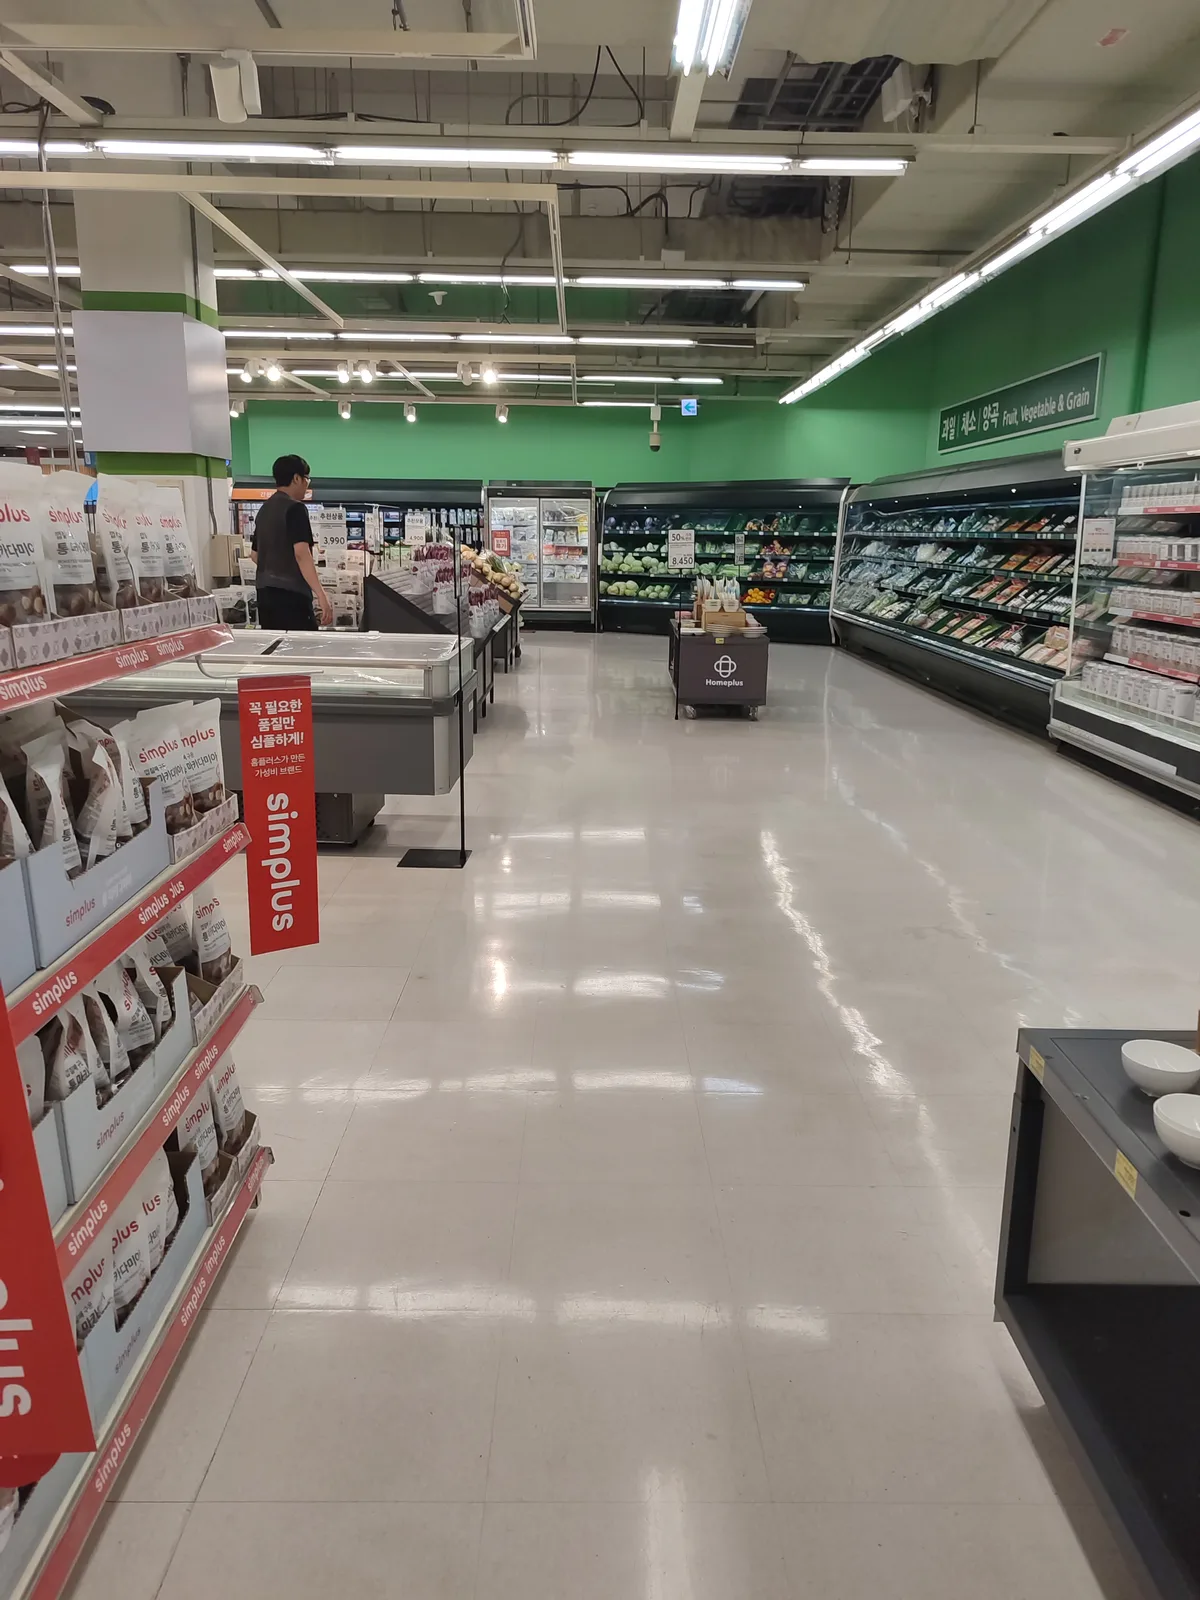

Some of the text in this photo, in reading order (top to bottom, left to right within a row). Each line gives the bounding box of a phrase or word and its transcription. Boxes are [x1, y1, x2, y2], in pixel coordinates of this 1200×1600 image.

[941, 401, 1000, 441] 과일 채소 양곡
[1002, 387, 1090, 427] Fruit, Vegetable & Grain
[323, 536, 345, 545] 3,990
[672, 557, 693, 565] 8,450
[115, 649, 150, 669] simplus
[157, 639, 185, 658] simplus
[0, 674, 47, 701] simplus
[705, 678, 744, 687] Homeplus
[249, 698, 302, 714] 꼭 필요한
[258, 716, 295, 731] 품질만
[250, 732, 304, 749] 심플하게!
[250, 753, 305, 767] 홈플러스가 만든
[255, 764, 303, 778] 가성비 브랜드
[261, 792, 300, 932] simplus
[65, 898, 96, 927] simplus
[138, 893, 170, 925] simplus
[32, 971, 77, 1015] simplus
[194, 1045, 218, 1080] simplus
[162, 1085, 190, 1127] simplus
[185, 1101, 209, 1133] simplu
[97, 1111, 124, 1150] simplus
[68, 1199, 109, 1256] simplus
[180, 1277, 206, 1327] simplus
[95, 1423, 131, 1493] simplus
